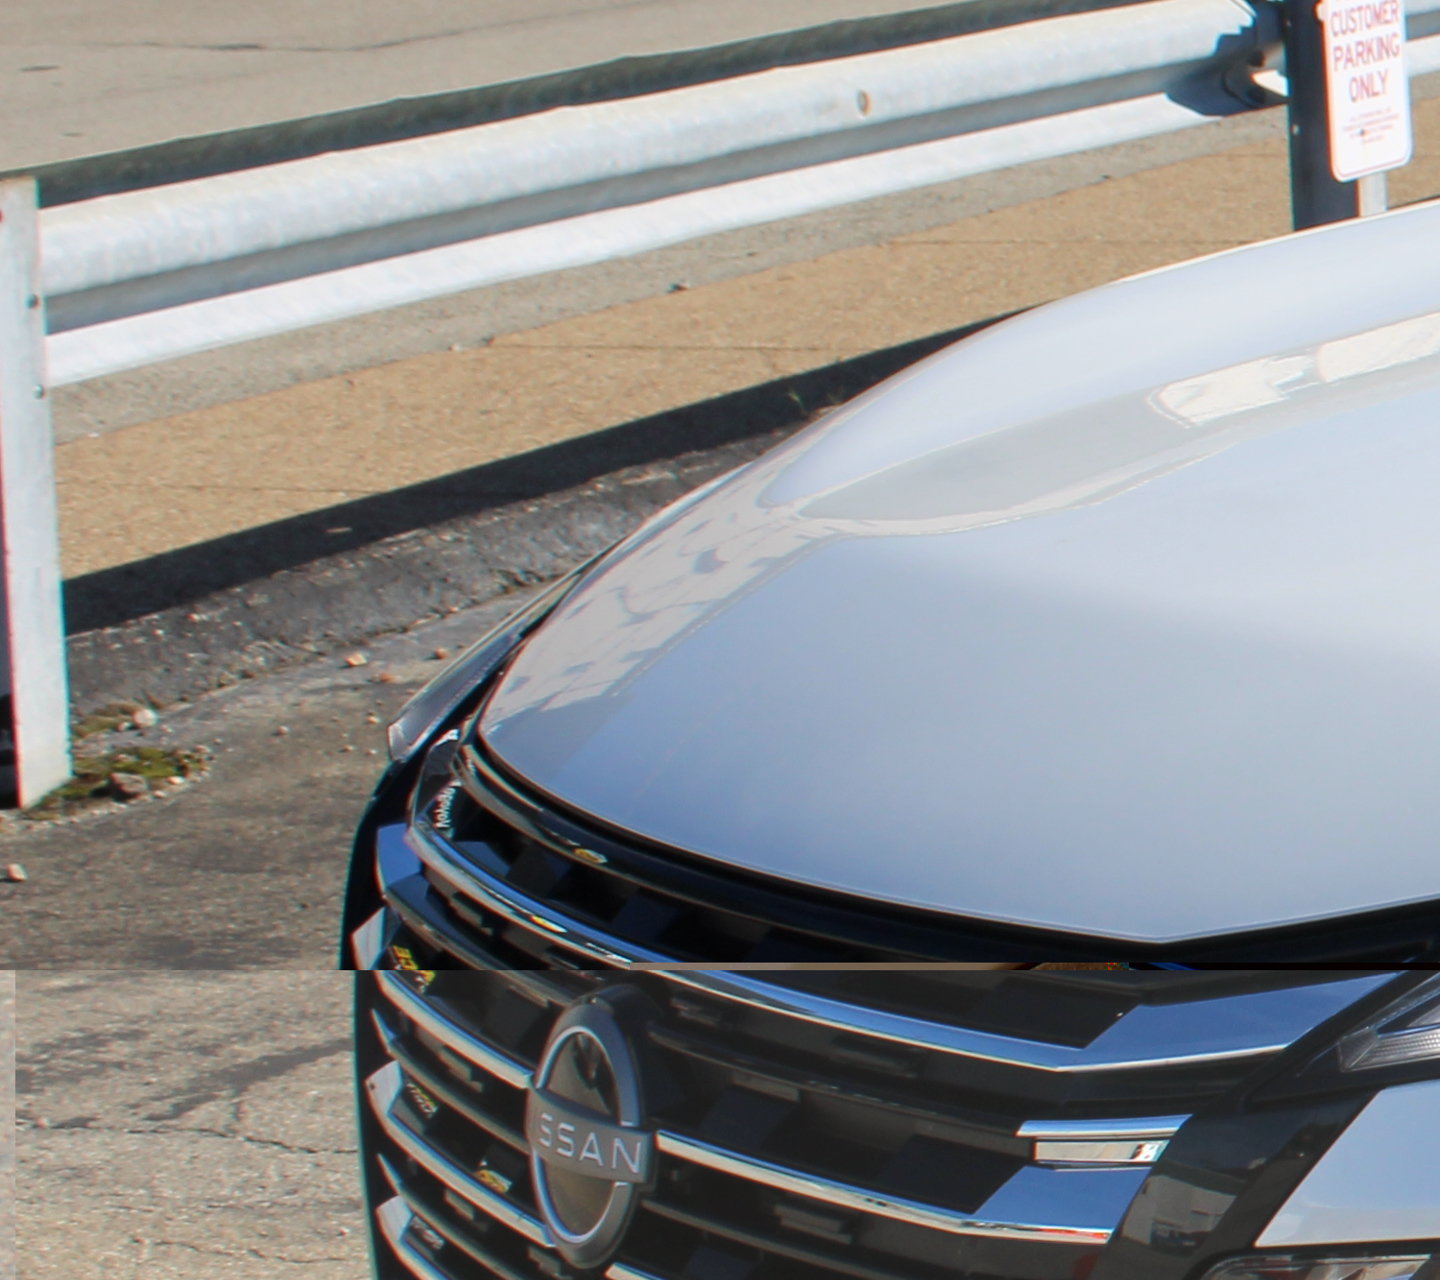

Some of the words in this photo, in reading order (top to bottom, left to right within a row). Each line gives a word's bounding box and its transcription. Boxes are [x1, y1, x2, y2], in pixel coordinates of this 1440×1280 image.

[1330, 1, 1400, 37] CUSTOMER
[1332, 33, 1401, 71] PARKING
[1348, 70, 1390, 103] ONLY
